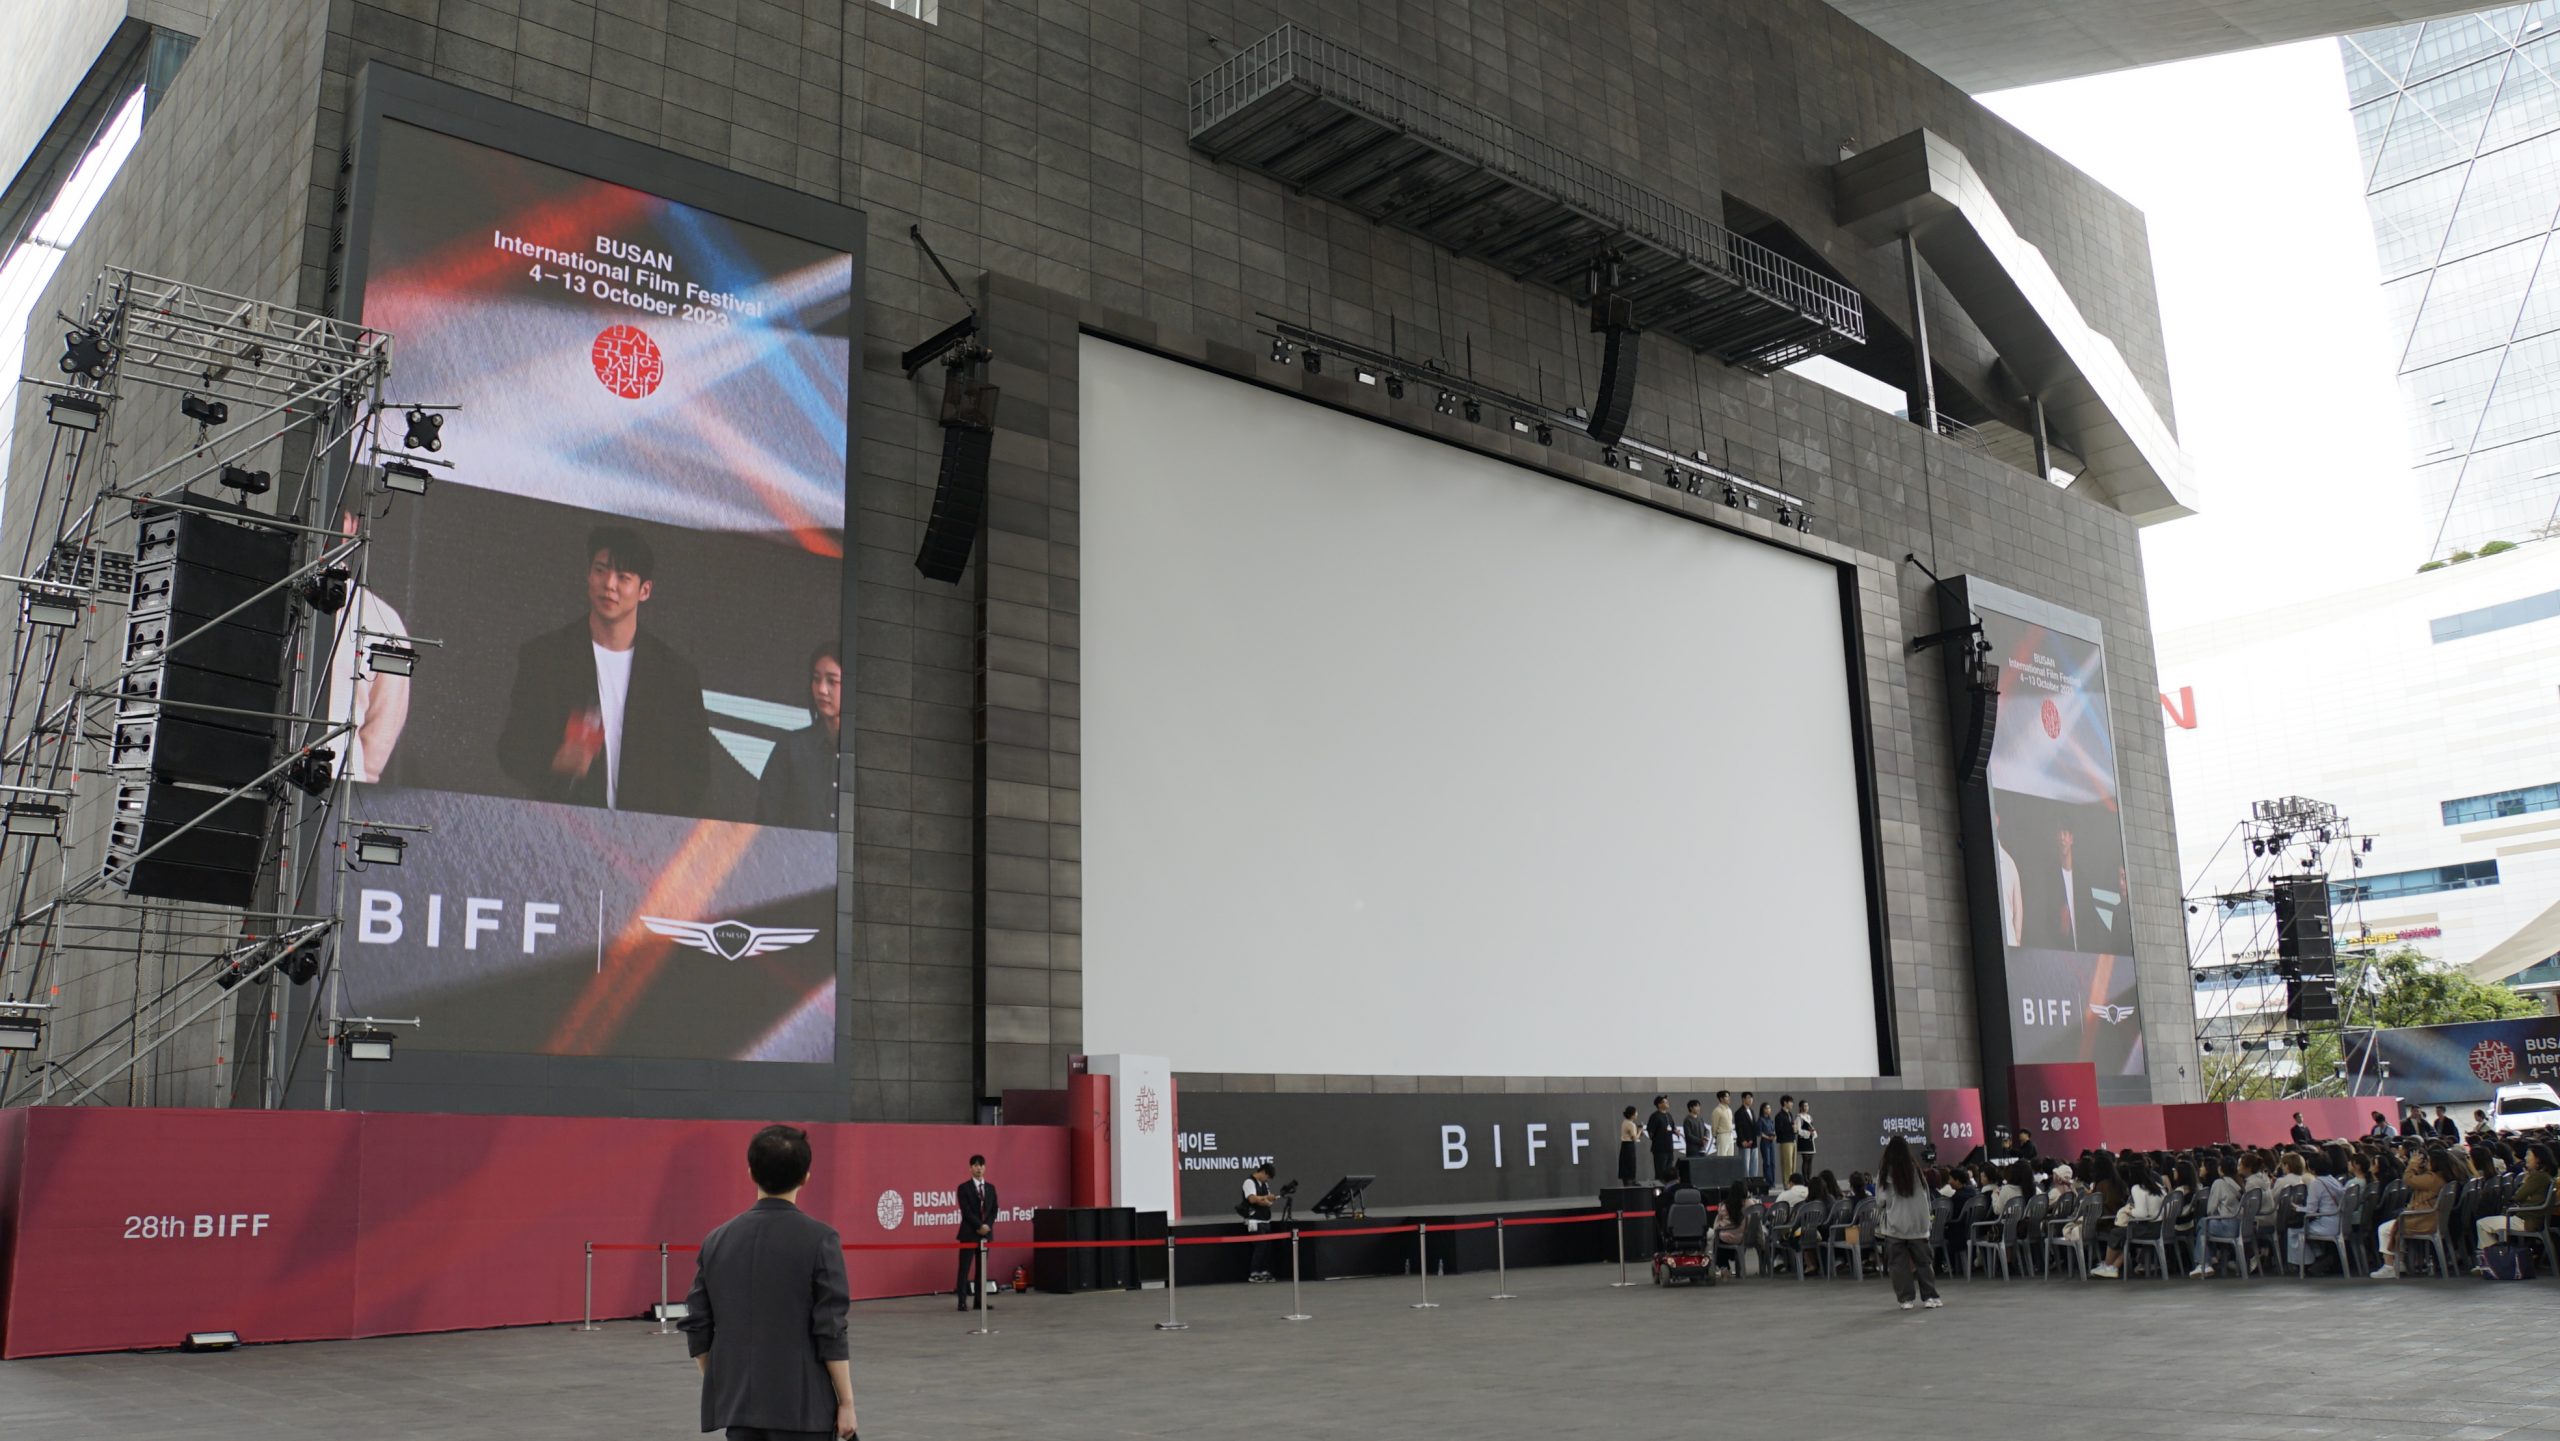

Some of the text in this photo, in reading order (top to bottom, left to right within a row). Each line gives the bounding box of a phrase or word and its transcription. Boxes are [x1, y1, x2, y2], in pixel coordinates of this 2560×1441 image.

[596, 236, 673, 272] BUSAN
[494, 230, 763, 318] International Film Festival
[592, 280, 676, 317] October
[682, 304, 729, 330] 2023
[2033, 652, 2056, 668] BUSAN
[358, 888, 560, 954] BIFF
[716, 931, 748, 941] GENESIS
[2022, 997, 2072, 1027] BIFF
[2040, 1098, 2077, 1113] BIFF
[1441, 1122, 1590, 1170] BIFF
[1184, 1156, 1239, 1171] RUNNING
[913, 1191, 957, 1208] BUSAN
[123, 1214, 270, 1239] 28th BIFF
